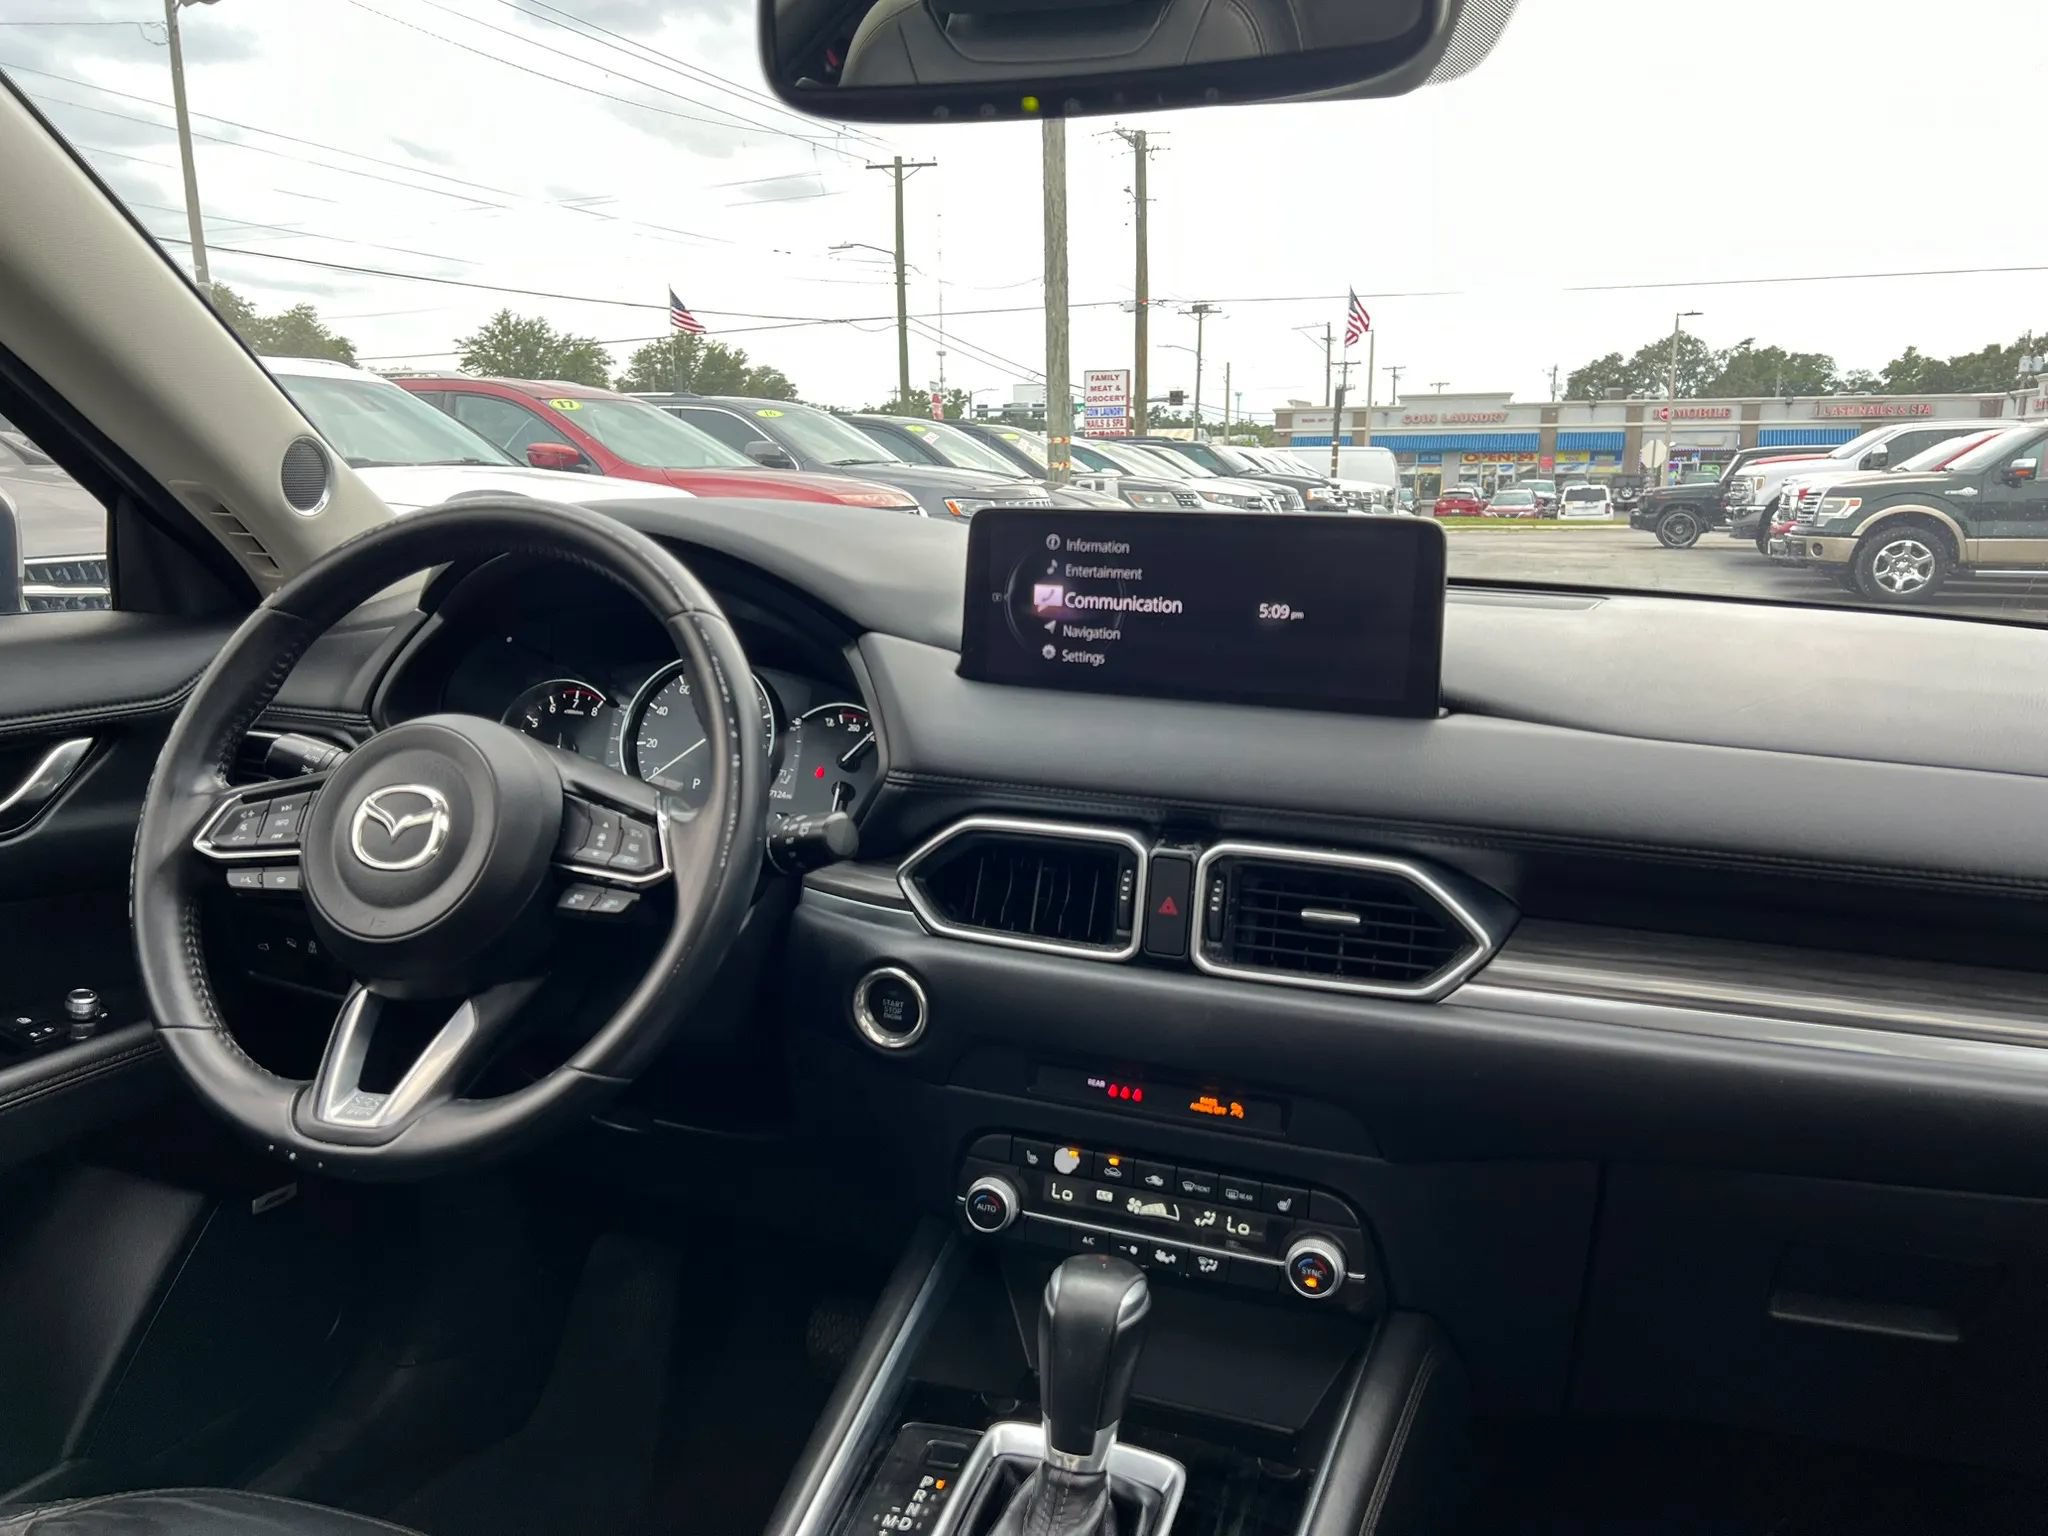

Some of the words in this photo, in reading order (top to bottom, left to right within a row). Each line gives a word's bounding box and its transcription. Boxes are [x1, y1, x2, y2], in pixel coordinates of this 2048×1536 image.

[557, 400, 574, 408] 17
[1859, 404, 1894, 415] NAILS
[1911, 404, 1932, 414] SPA
[1402, 413, 1437, 425] COIN
[1441, 411, 1509, 424] LAUNDRY
[1066, 538, 1130, 554] Information
[1065, 563, 1143, 580] Entertainment
[1064, 592, 1183, 614] Communication
[1259, 603, 1290, 619] 5:09
[1063, 624, 1121, 641] Navigation
[1062, 649, 1105, 667] Settings
[549, 703, 556, 713] 6
[573, 699, 579, 708] 7
[591, 706, 598, 717] 8
[656, 706, 669, 716] 40
[531, 718, 539, 728] 5
[646, 738, 658, 748] 20
[692, 778, 701, 789] P
[1088, 1078, 1106, 1088] REAR
[1051, 1182, 1074, 1202] Lo
[976, 1203, 997, 1213] AUTO
[1226, 1215, 1251, 1236] Lo
[1301, 1266, 1323, 1278] SYNC
[919, 1475, 935, 1489] P
[913, 1488, 928, 1502] R
[905, 1502, 921, 1517] N
[898, 1516, 913, 1531] D
